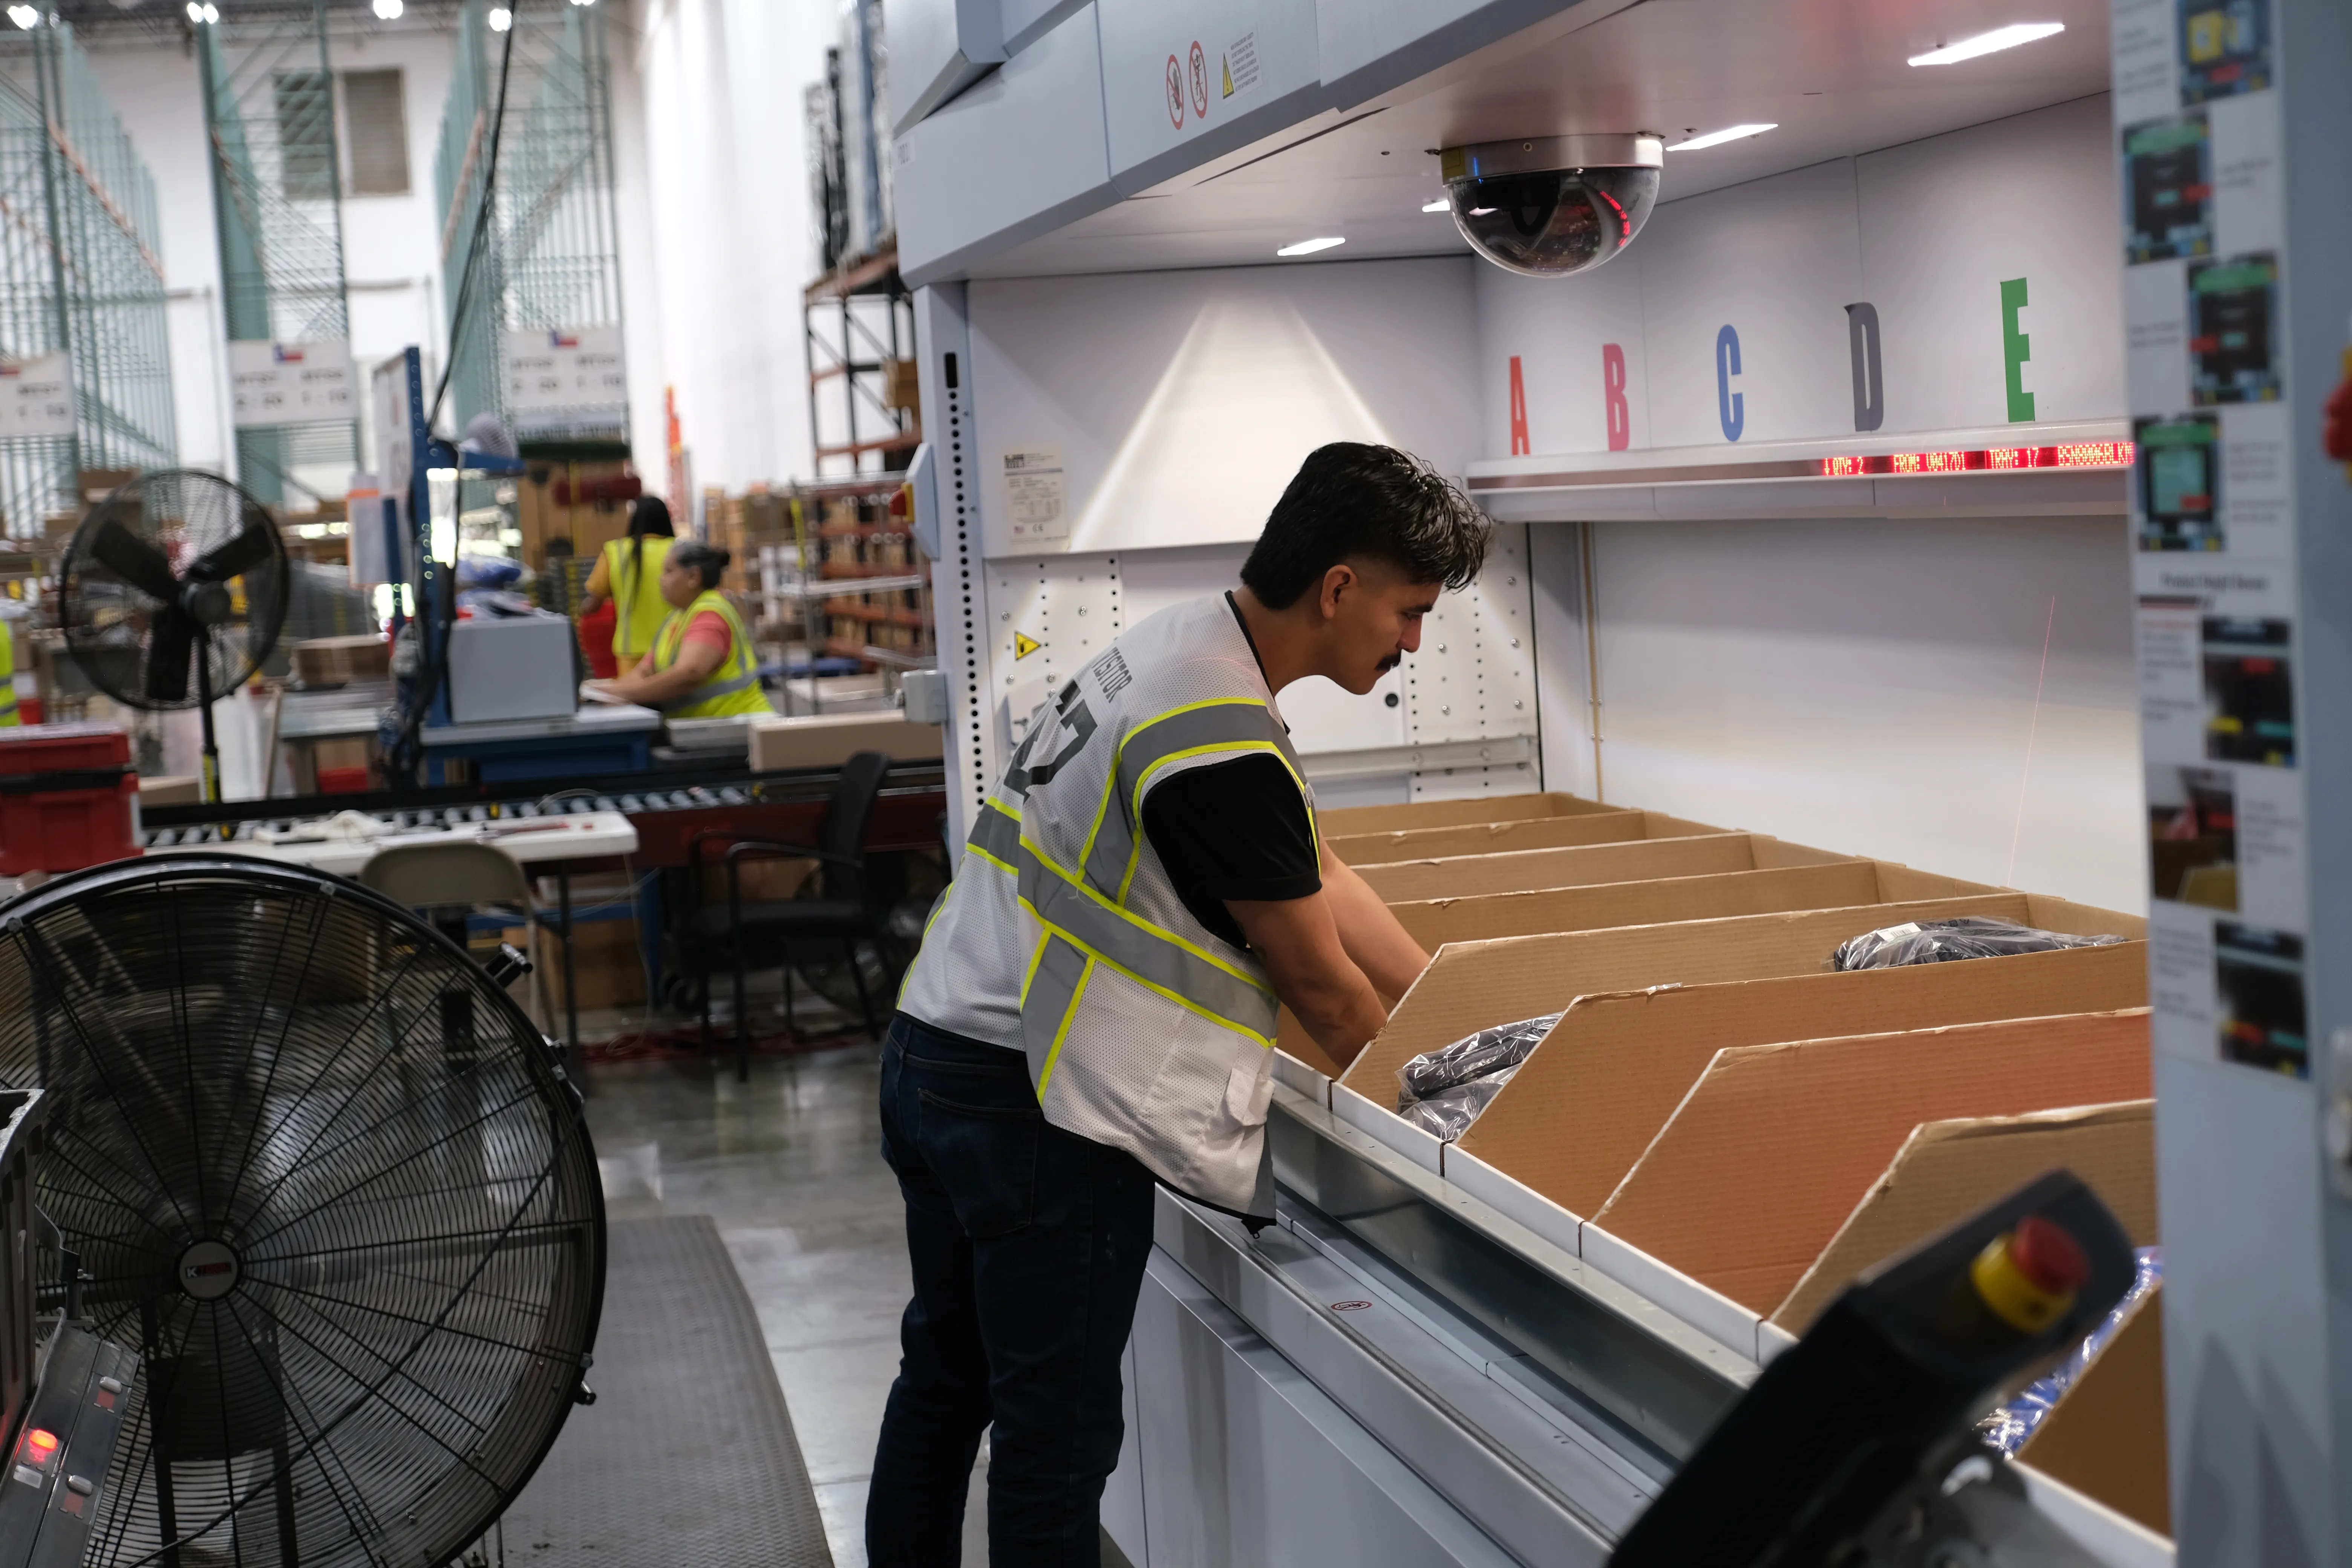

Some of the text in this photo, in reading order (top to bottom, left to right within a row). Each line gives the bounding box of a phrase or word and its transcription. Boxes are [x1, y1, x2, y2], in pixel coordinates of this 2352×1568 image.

[1603, 343, 1629, 452] B
[1716, 324, 1744, 442] C
[1843, 302, 1884, 432] D
[2000, 277, 2035, 422] E
[1510, 355, 1530, 455] A
[1832, 457, 1851, 475] QTY:
[1857, 456, 1864, 475] 2
[1893, 453, 1920, 473] FROM:
[1989, 448, 2018, 469] TRAY:
[2027, 447, 2039, 467] 17
[1092, 646, 1132, 703] VISITOR
